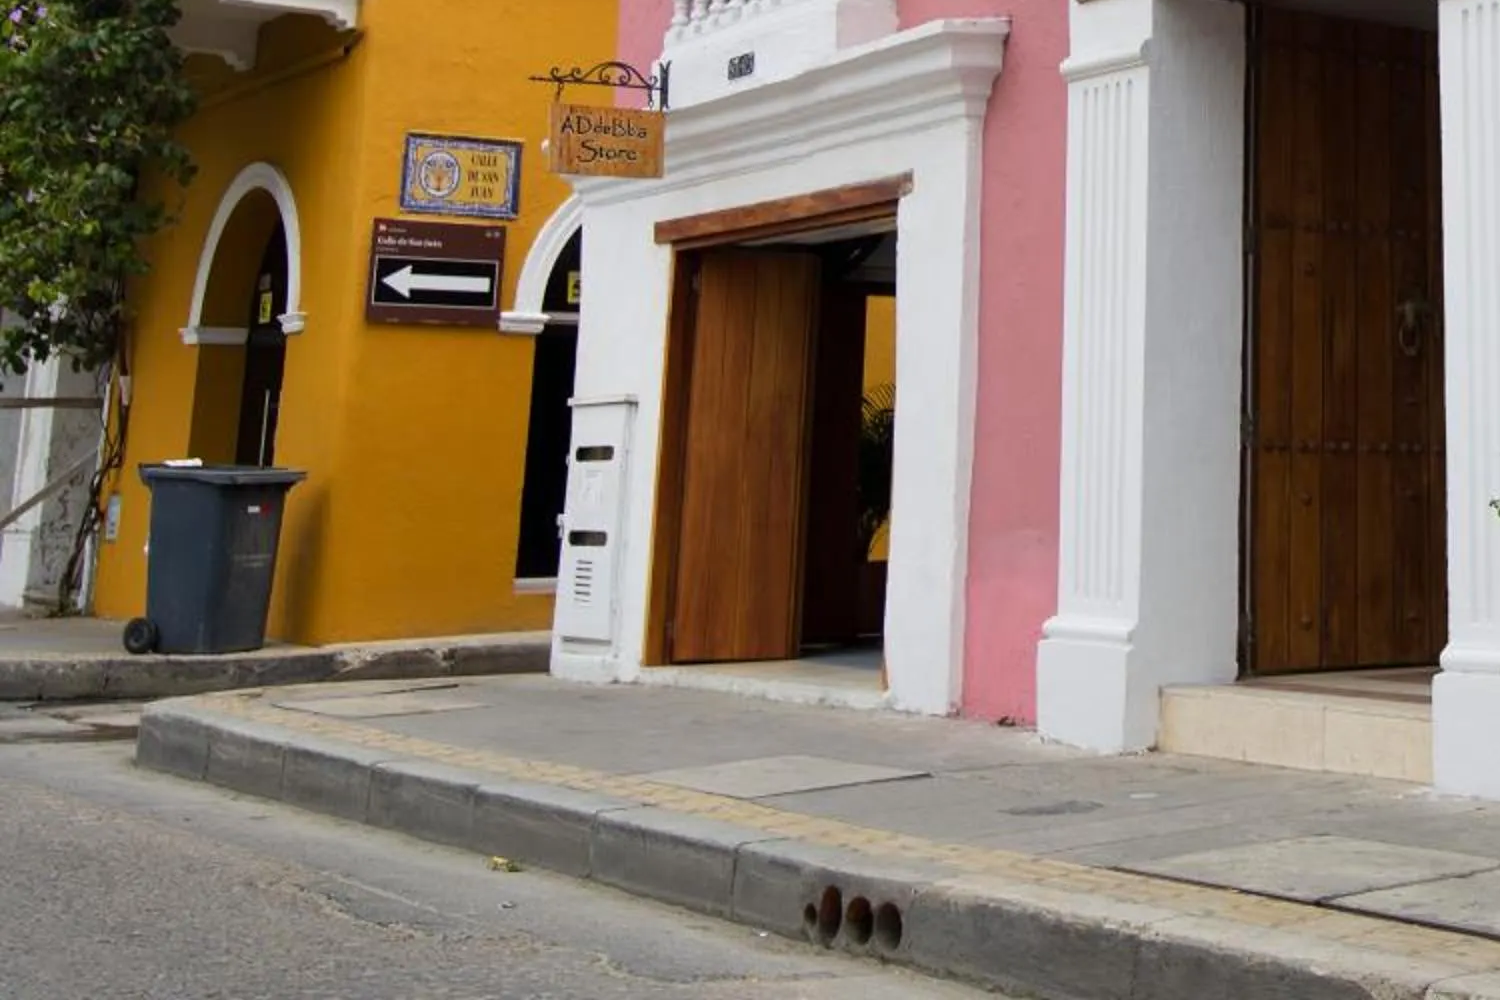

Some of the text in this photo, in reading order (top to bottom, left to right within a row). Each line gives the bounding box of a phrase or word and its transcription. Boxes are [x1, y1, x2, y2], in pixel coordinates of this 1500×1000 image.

[577, 140, 637, 163] Store
[471, 153, 498, 167] CALLE
[467, 171, 499, 184] DE SAN
[470, 186, 493, 199] JUAN
